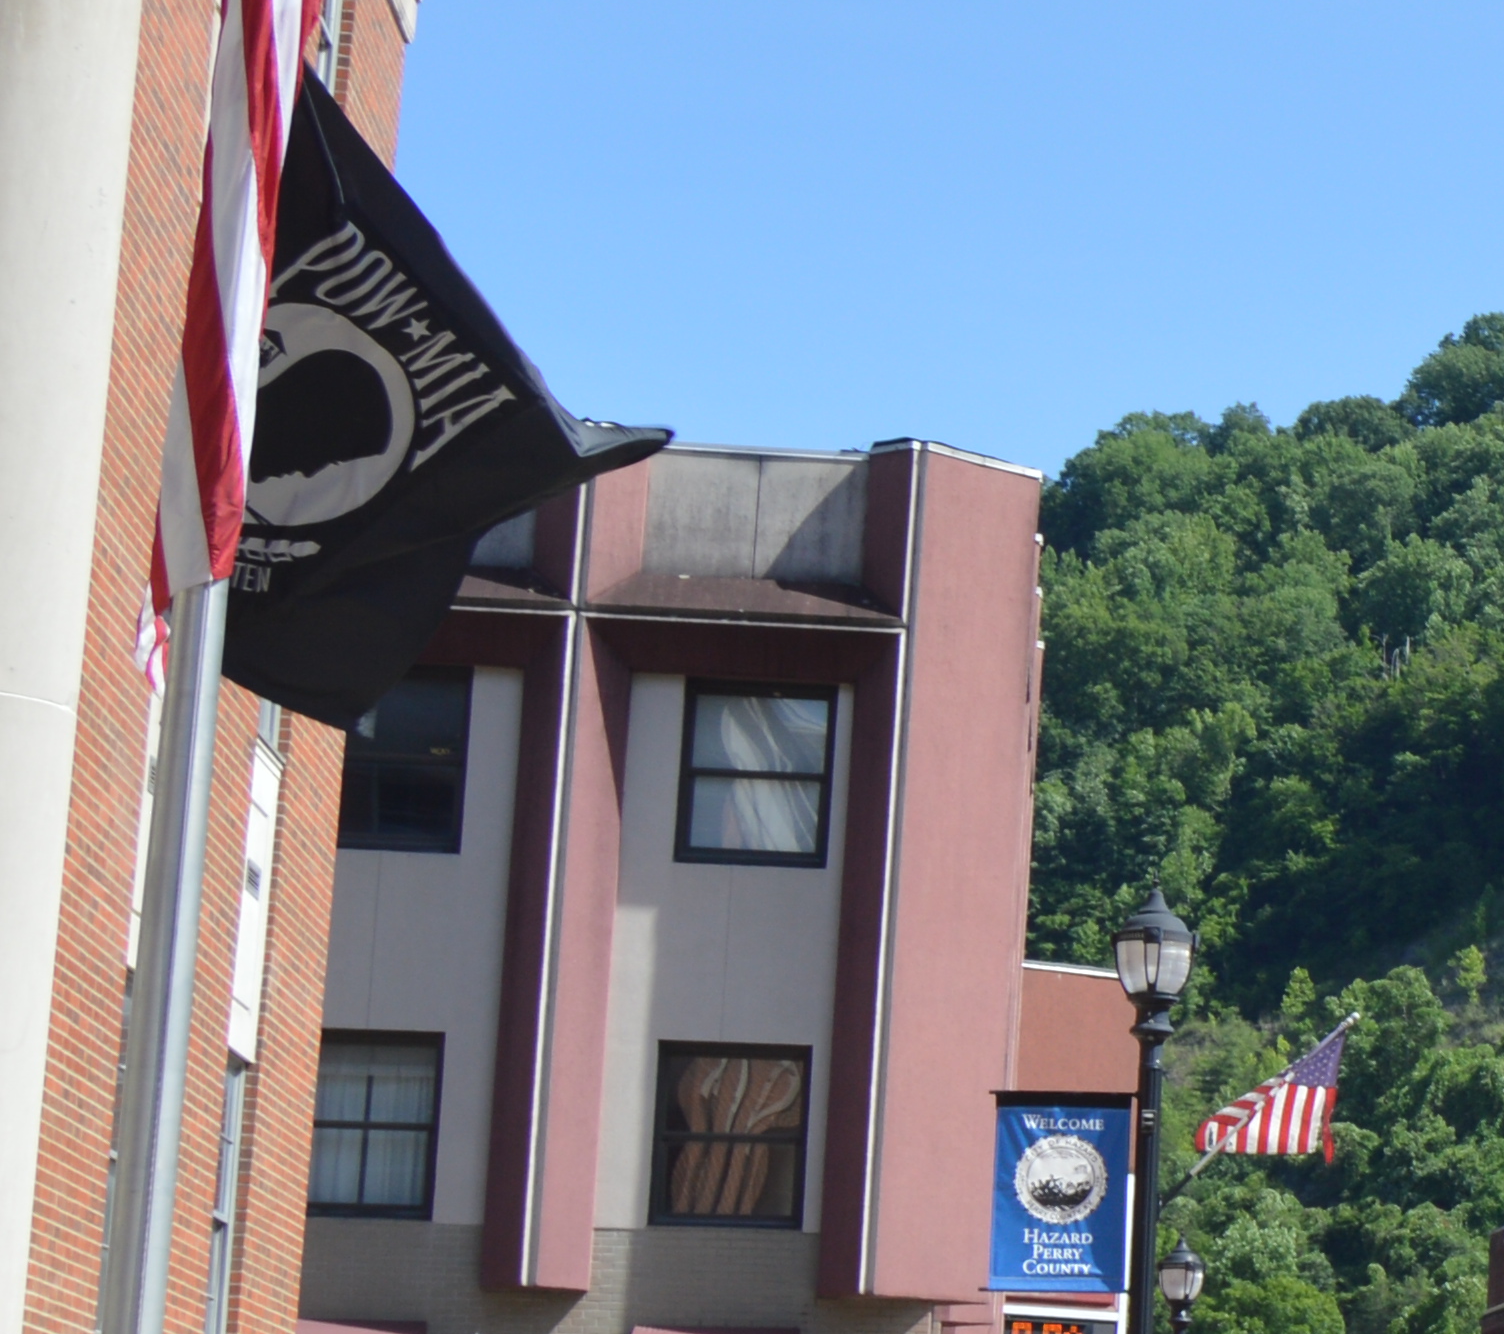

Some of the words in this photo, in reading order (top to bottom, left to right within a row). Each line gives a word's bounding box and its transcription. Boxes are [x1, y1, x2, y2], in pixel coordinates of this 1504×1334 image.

[271, 220, 428, 330] POW
[399, 330, 517, 472] MIA
[1022, 1113, 1104, 1131] WELCOME
[1023, 1228, 1093, 1244] HAZARD
[1032, 1244, 1083, 1259] PERRY
[1022, 1259, 1092, 1275] COUNTY
